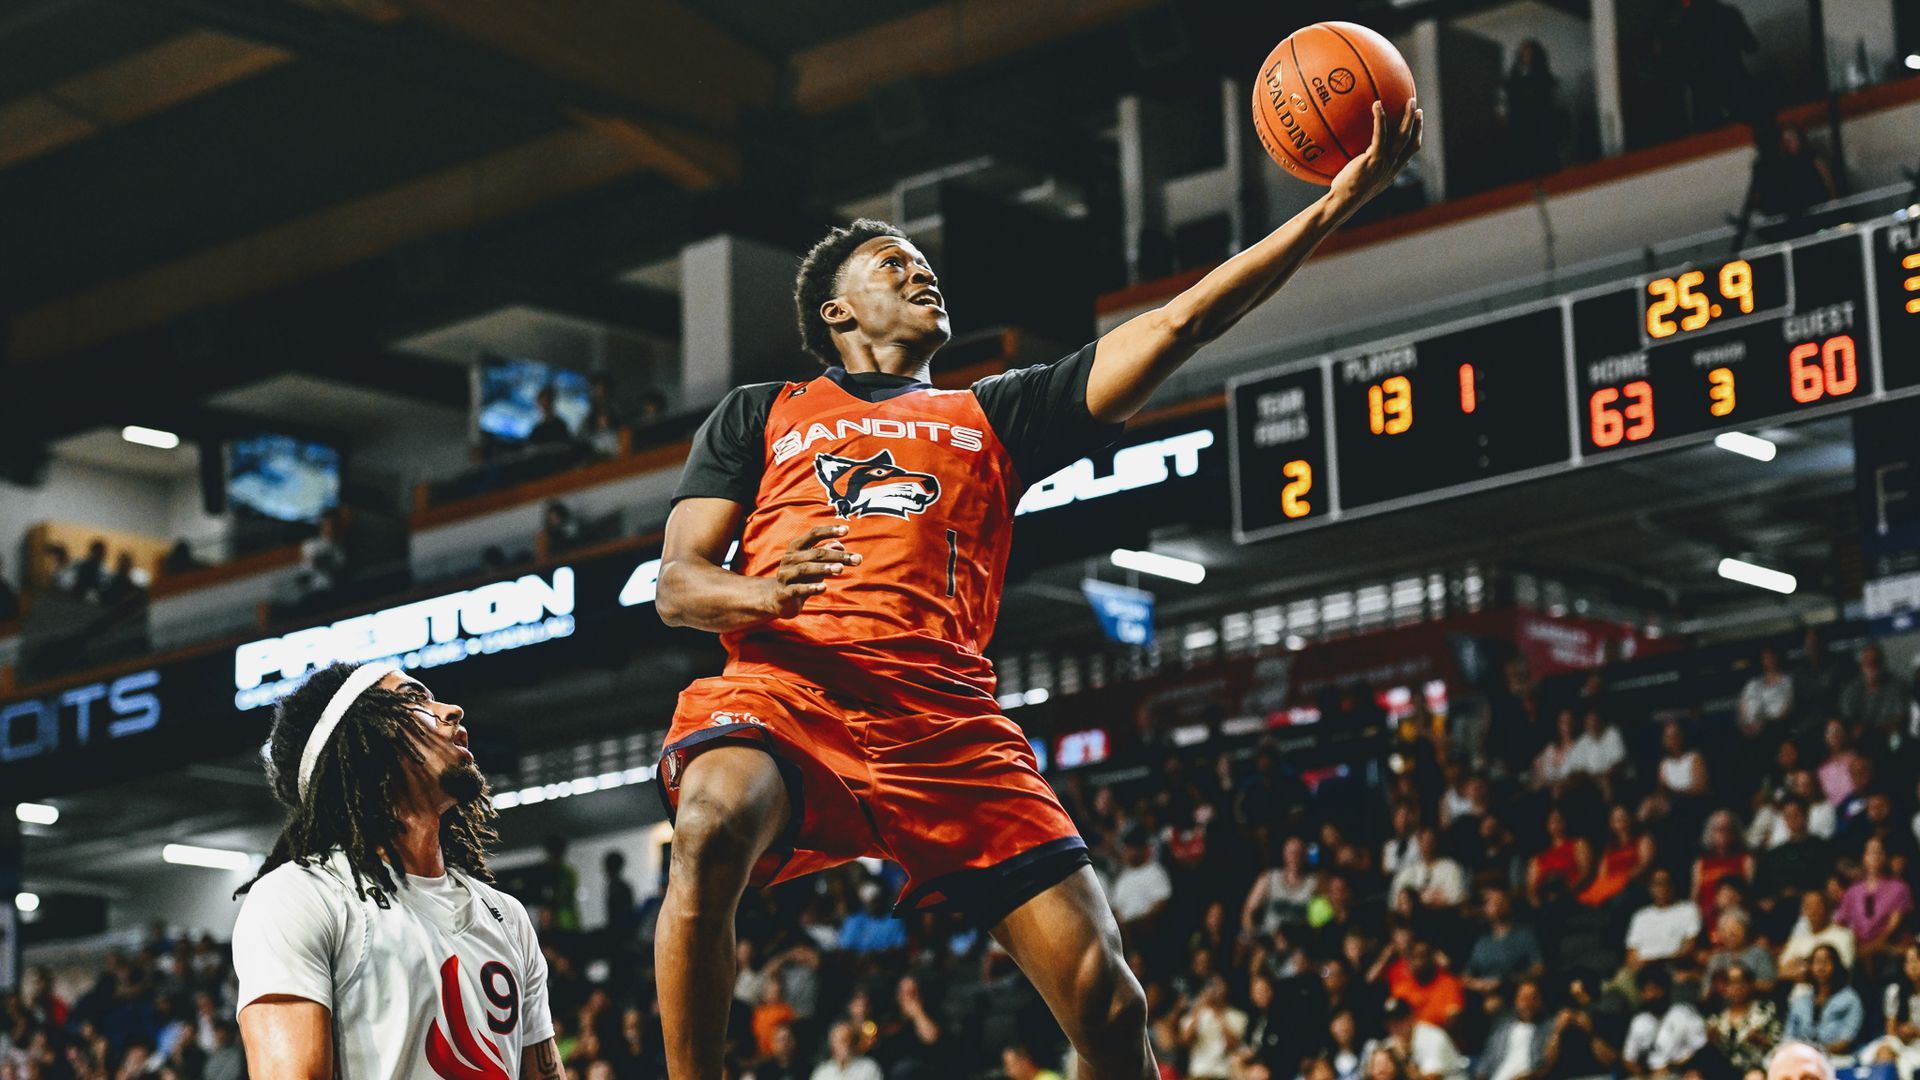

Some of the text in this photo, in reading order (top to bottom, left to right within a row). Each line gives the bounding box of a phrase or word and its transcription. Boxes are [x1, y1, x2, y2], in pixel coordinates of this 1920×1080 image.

[1265, 60, 1325, 162] SPALDING
[1312, 77, 1332, 107] CEBL
[1647, 260, 1754, 338] 25.9
[1783, 301, 1855, 343] GUEST
[1458, 363, 1476, 414] 1
[1708, 367, 1736, 417] 3
[1789, 335, 1858, 403] 60
[1368, 375, 1414, 435] 13
[1590, 380, 1655, 448] 63
[771, 417, 984, 466] BANDITS
[1014, 429, 1214, 516] OLET
[1281, 459, 1313, 519] 2
[235, 566, 575, 690] PRESTON
[479, 960, 520, 1036] 9
